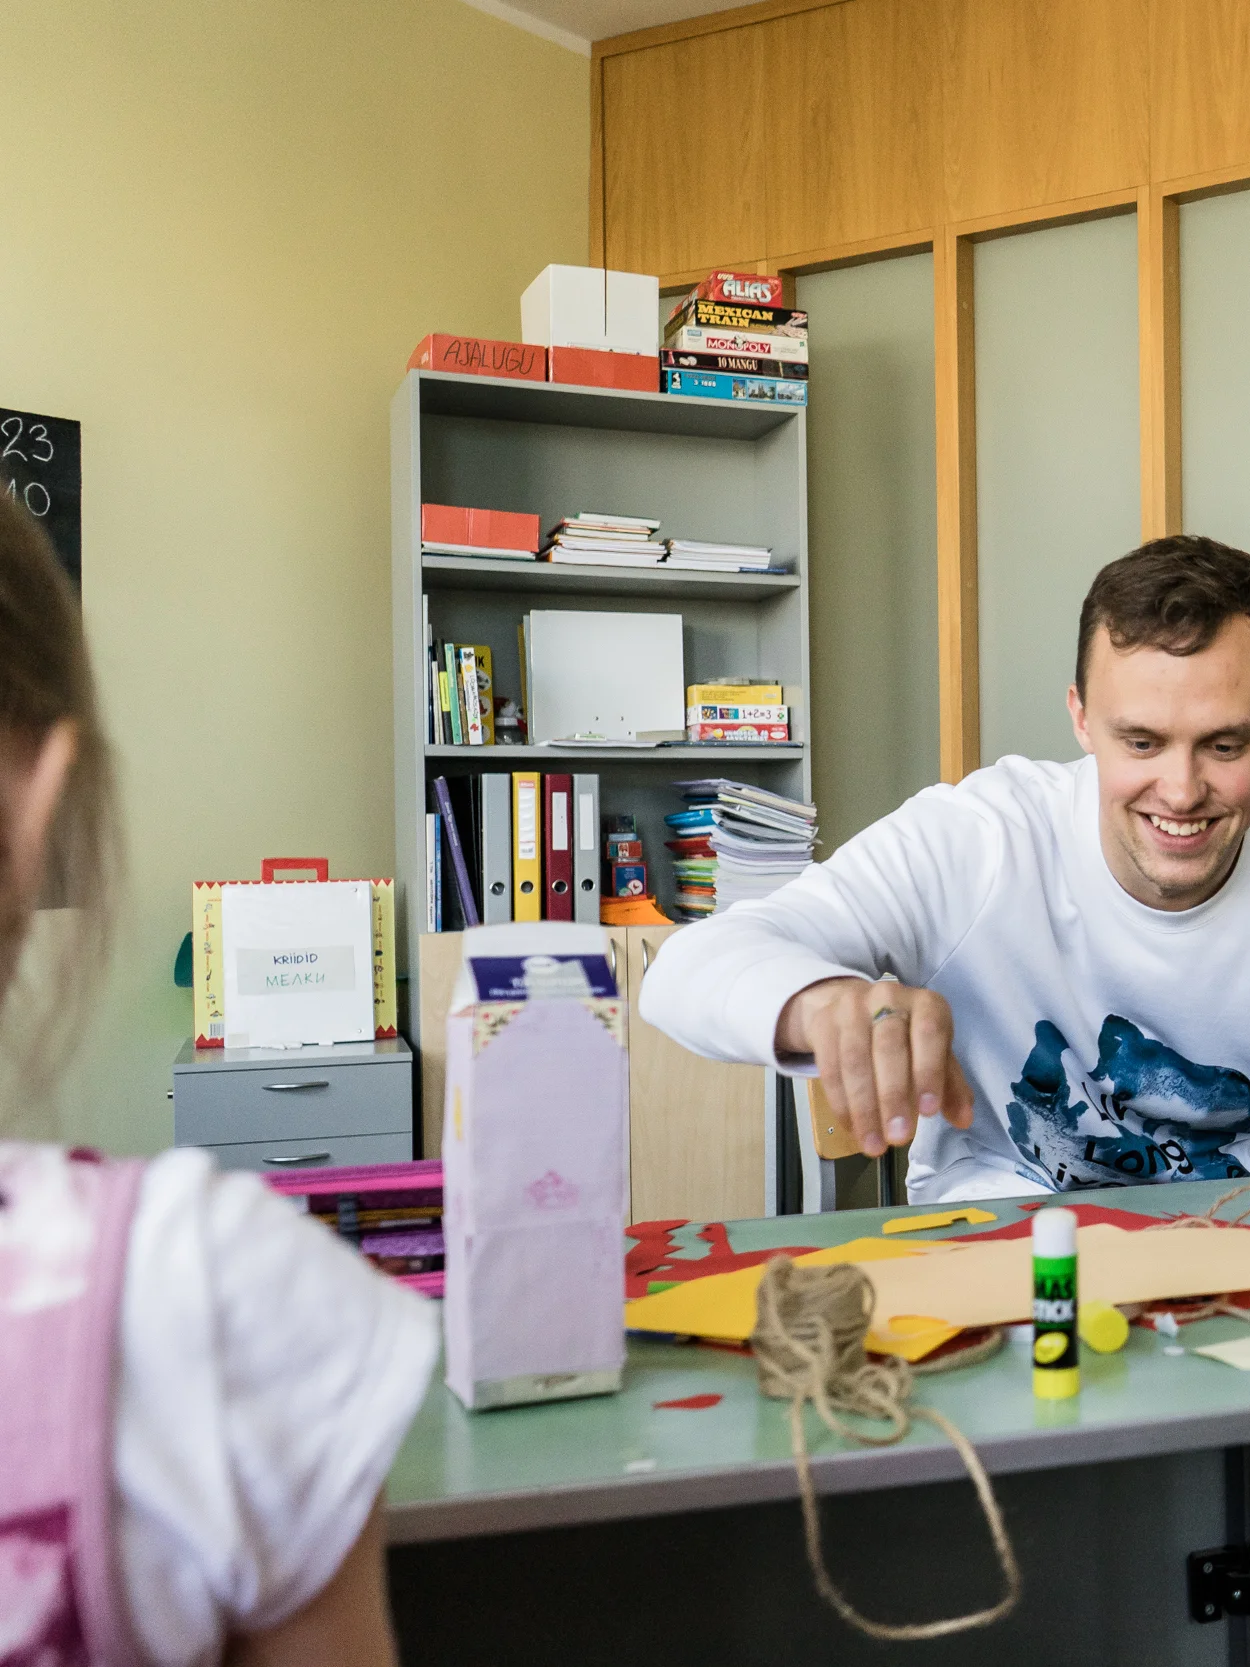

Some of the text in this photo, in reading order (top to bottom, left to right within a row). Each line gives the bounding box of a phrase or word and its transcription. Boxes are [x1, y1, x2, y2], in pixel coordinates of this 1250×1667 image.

[722, 280, 772, 303] ALIAS
[698, 304, 773, 321] MEXICAN
[698, 313, 750, 327] TRAIN
[707, 338, 770, 353] MONOPOLY
[443, 340, 535, 375] AJALUGU
[717, 356, 758, 370] 10 MANGU
[1, 417, 53, 462] 23
[1083, 1139, 1193, 1175] Long
